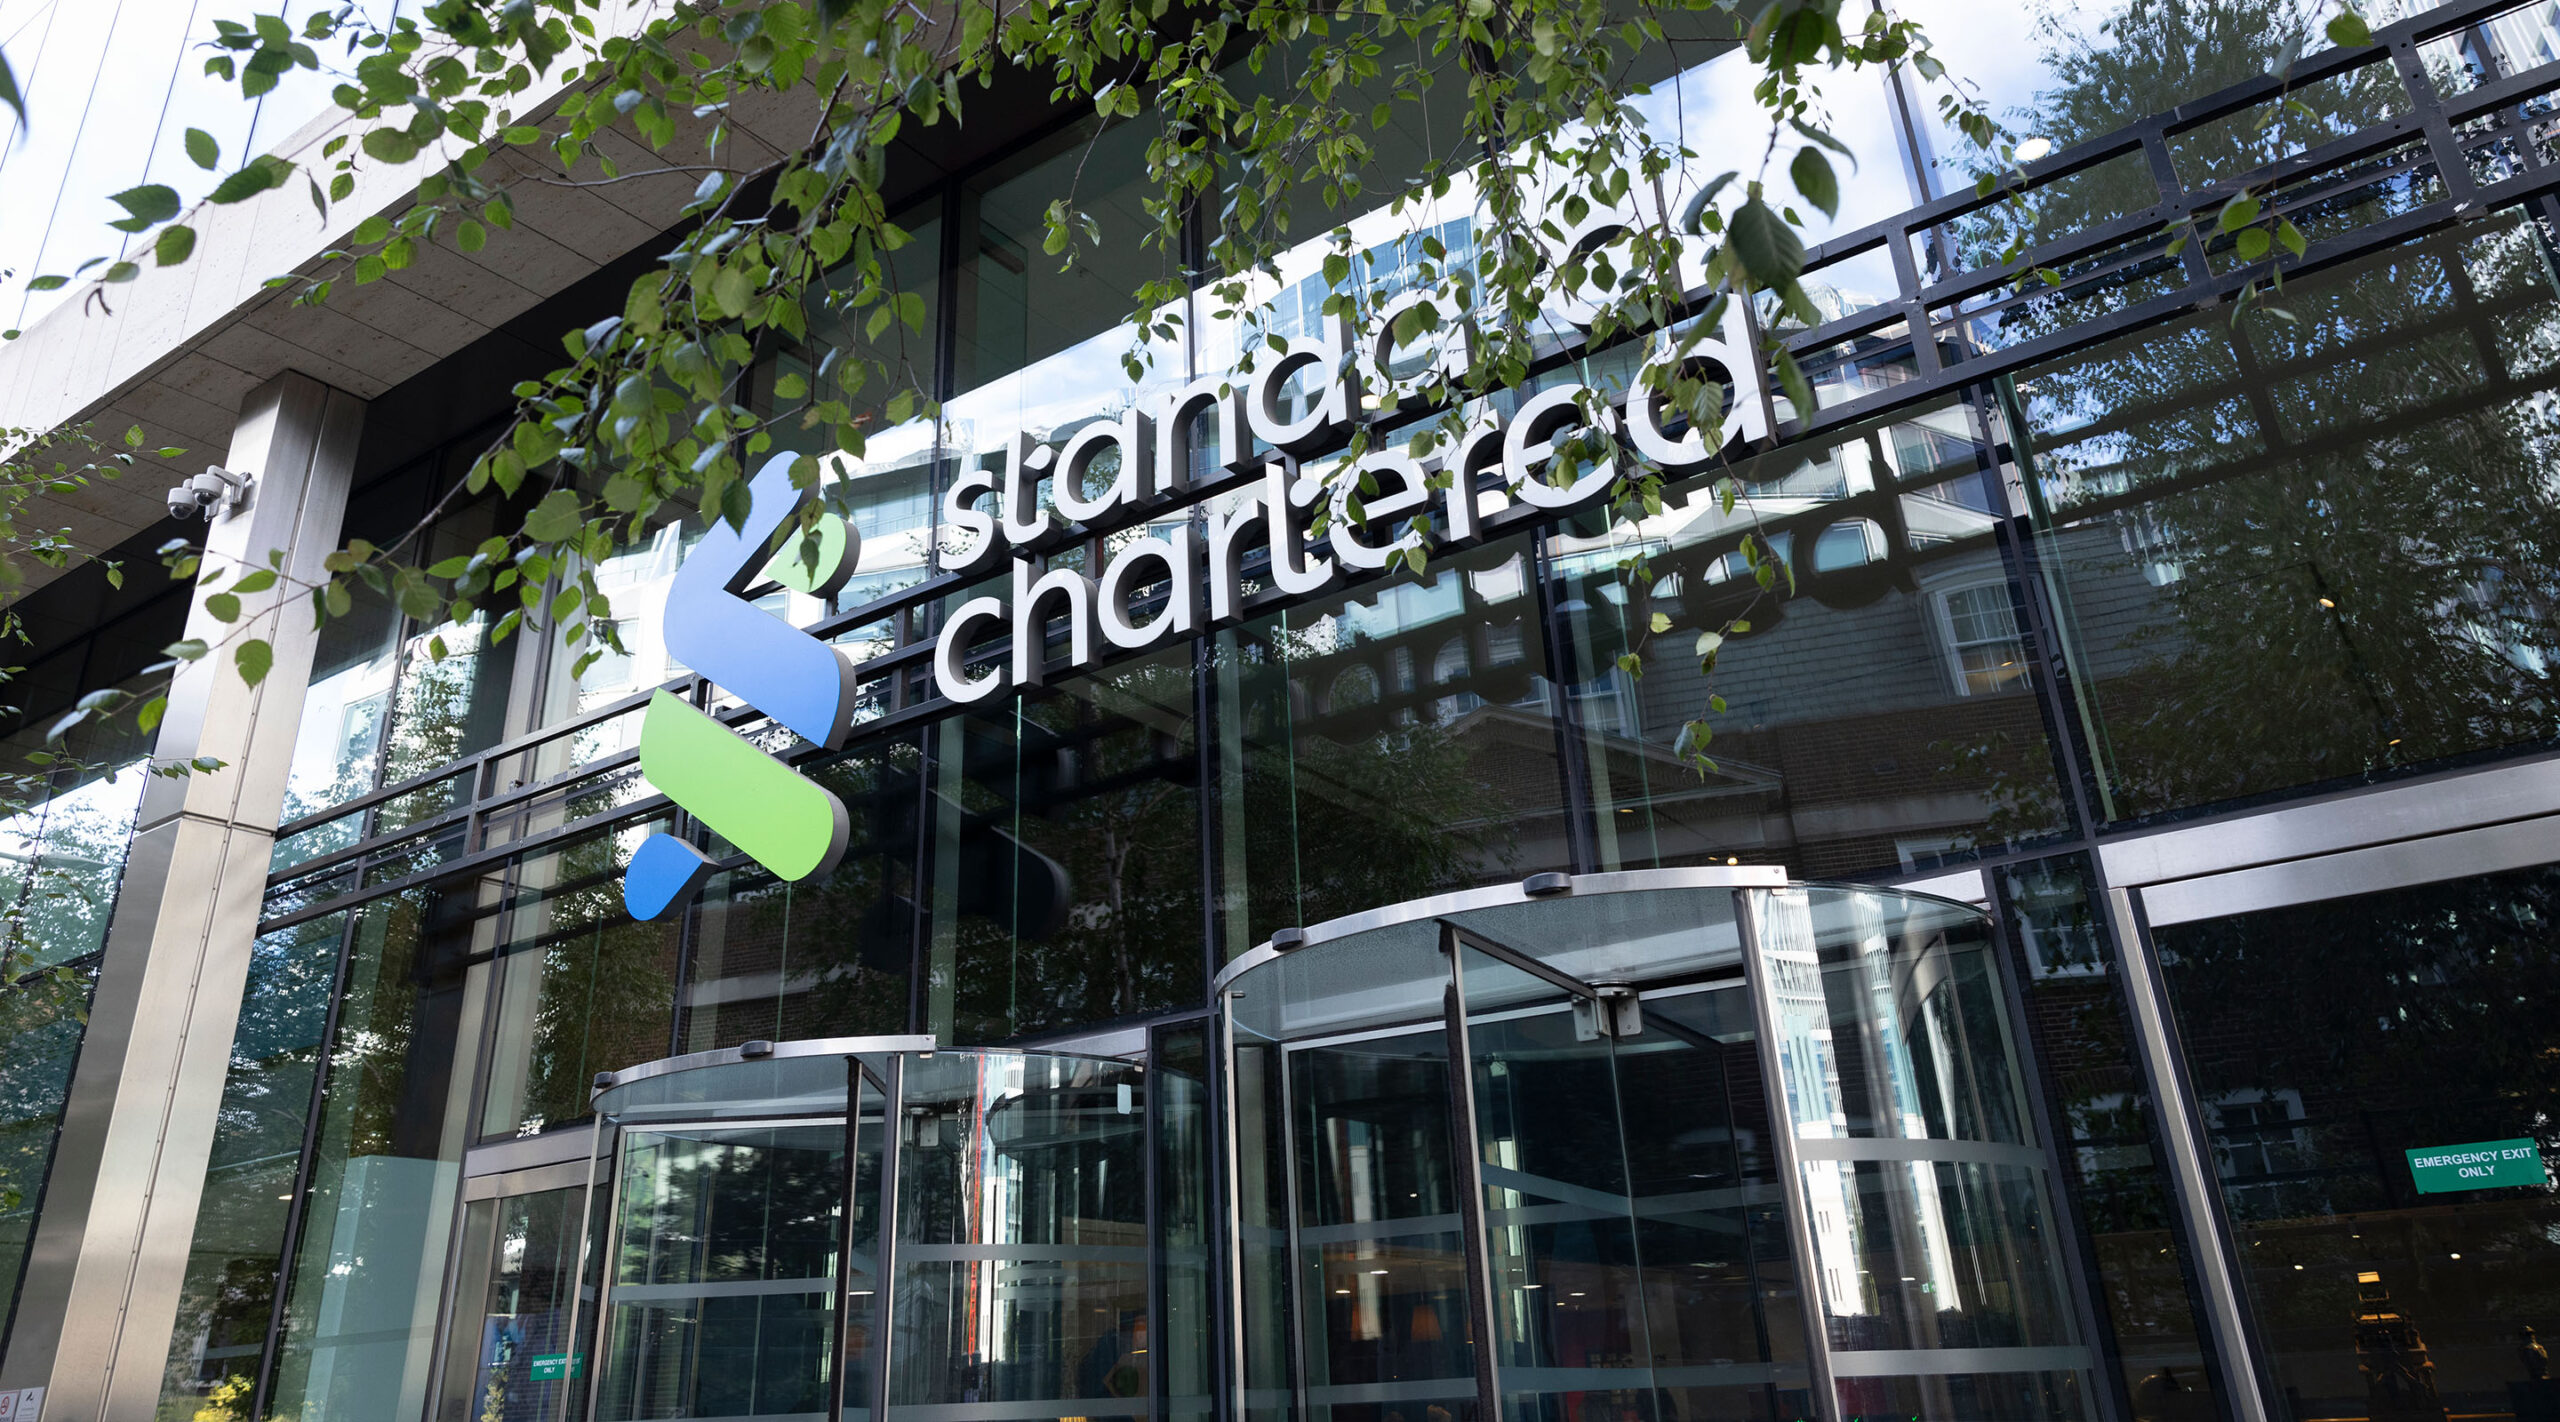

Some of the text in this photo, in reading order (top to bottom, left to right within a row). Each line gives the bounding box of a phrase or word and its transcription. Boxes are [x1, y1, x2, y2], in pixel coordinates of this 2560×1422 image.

[939, 160, 1676, 570] standad
[934, 289, 1769, 703] chartered
[2414, 1147, 2532, 1168] EMERGENCY EXIT
[2458, 1165, 2495, 1178] ONLY
